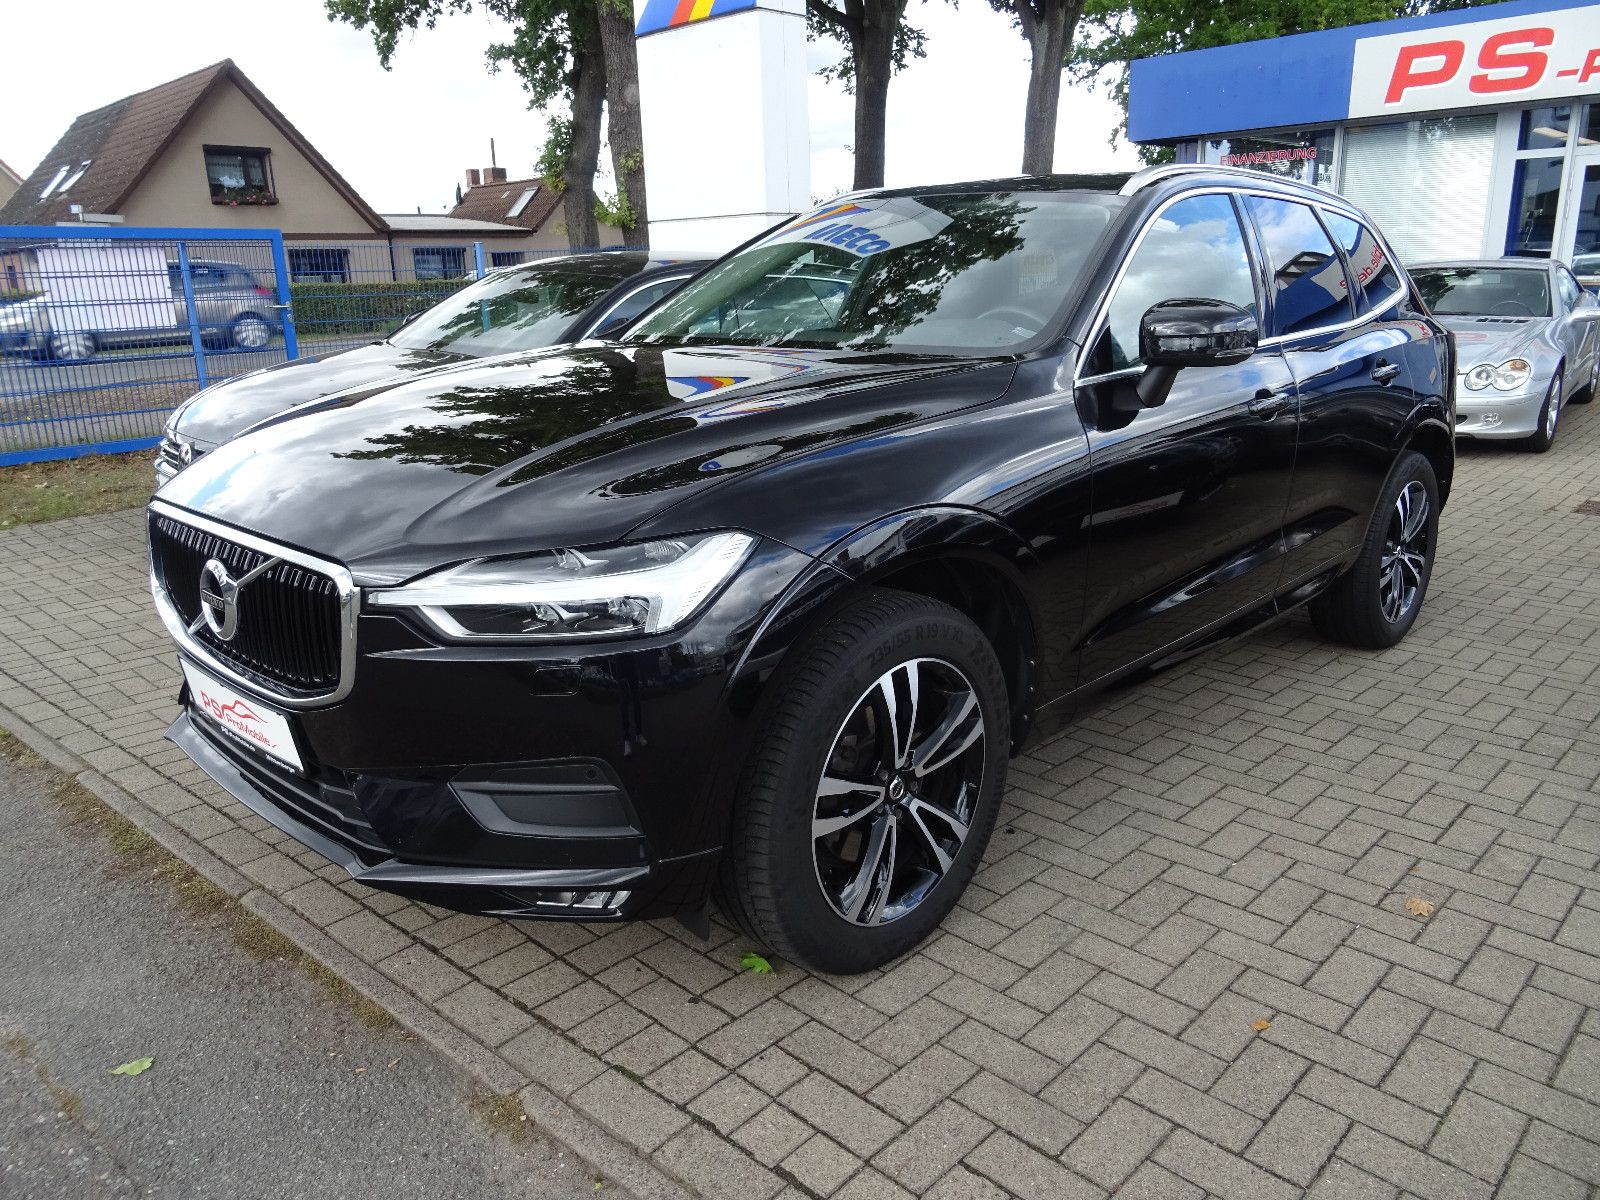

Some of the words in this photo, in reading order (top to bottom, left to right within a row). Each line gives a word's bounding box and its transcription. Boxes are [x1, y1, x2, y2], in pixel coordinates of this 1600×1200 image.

[1220, 147, 1317, 166] FINANZIERUNG
[202, 592, 224, 609] VOLVO
[926, 623, 939, 639] 19
[200, 690, 223, 719] PS
